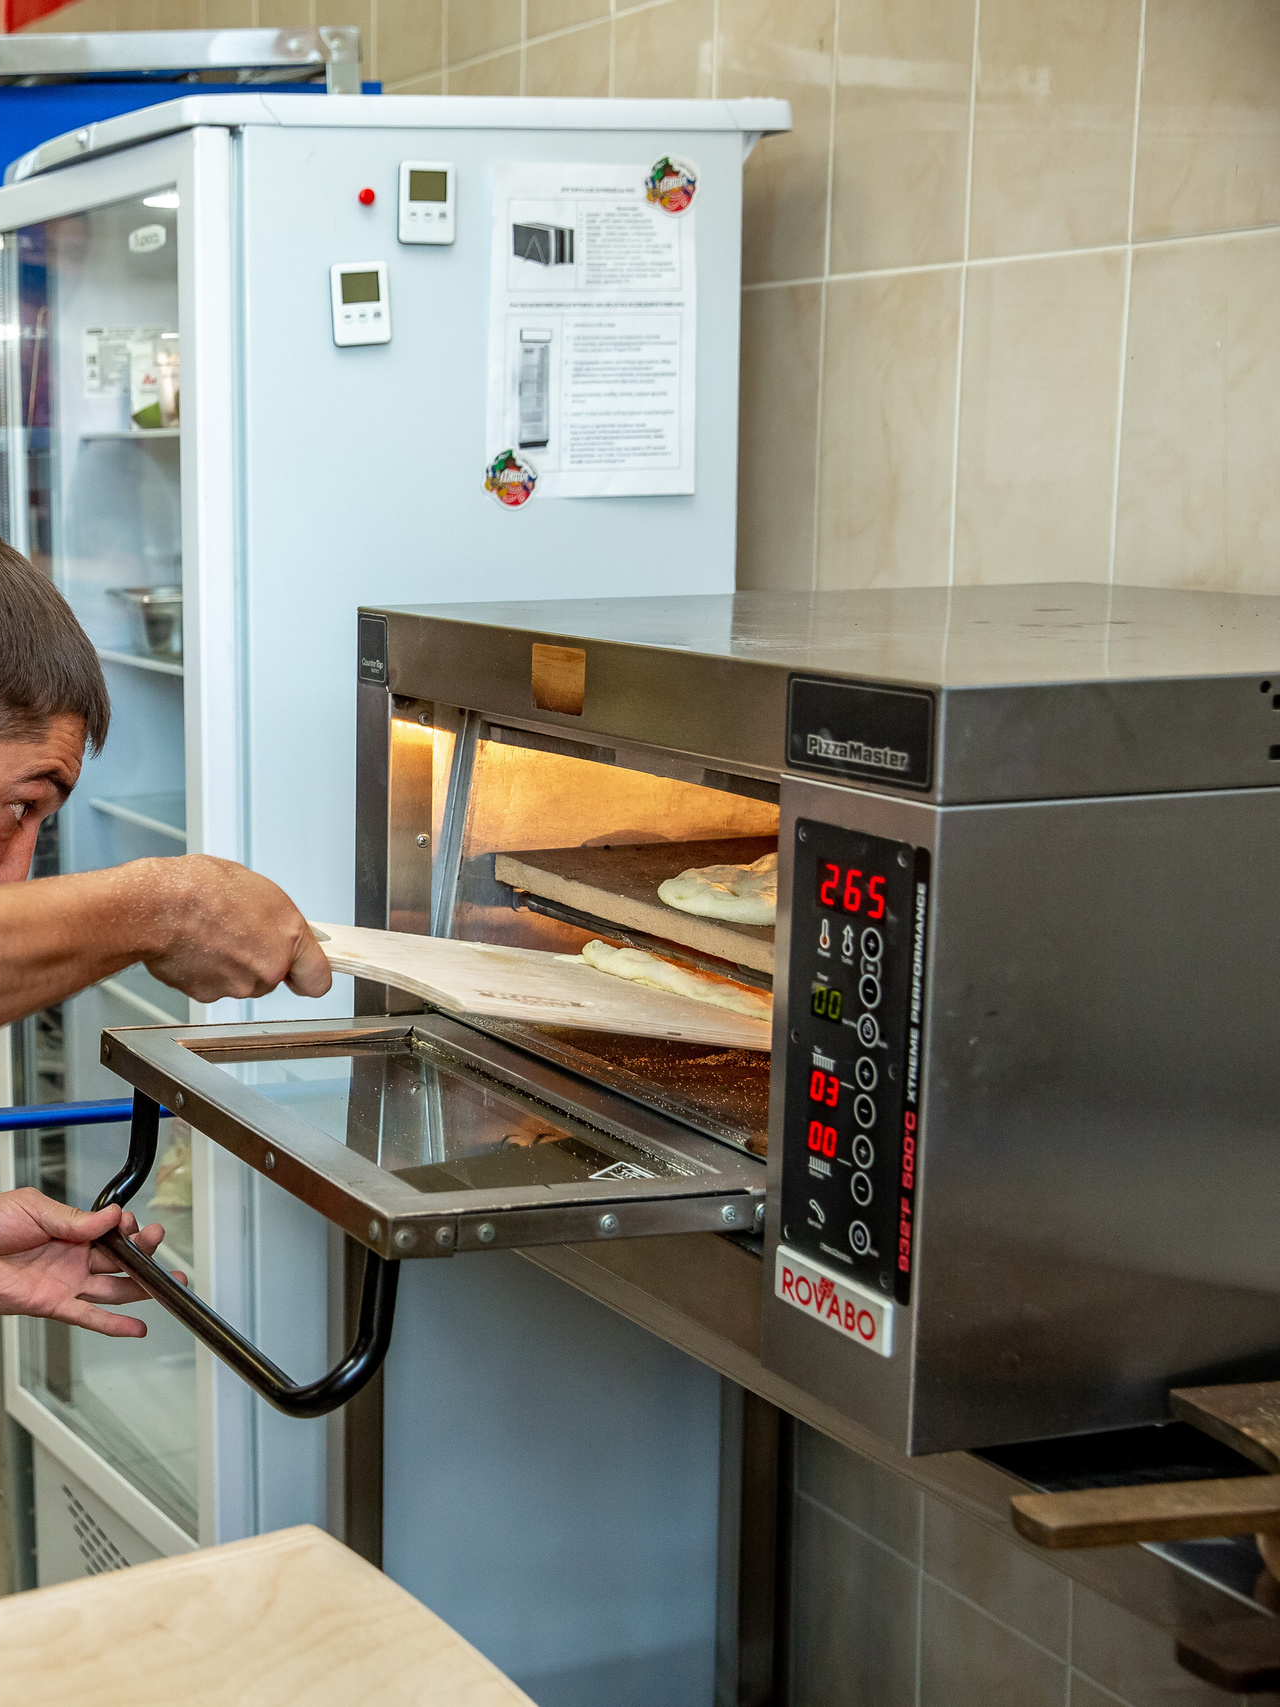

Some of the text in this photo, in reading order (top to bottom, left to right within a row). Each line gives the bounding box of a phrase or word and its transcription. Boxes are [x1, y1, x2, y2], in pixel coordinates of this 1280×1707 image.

[806, 734, 908, 771] PizzaMaster
[821, 864, 886, 919] 265
[910, 882, 927, 1025] PERFORMANCE
[813, 984, 843, 1020] 00
[907, 1027, 921, 1104] XTREME
[809, 1070, 839, 1108] 03
[807, 1120, 838, 1158] 00
[781, 1266, 876, 1341] ROVABO
